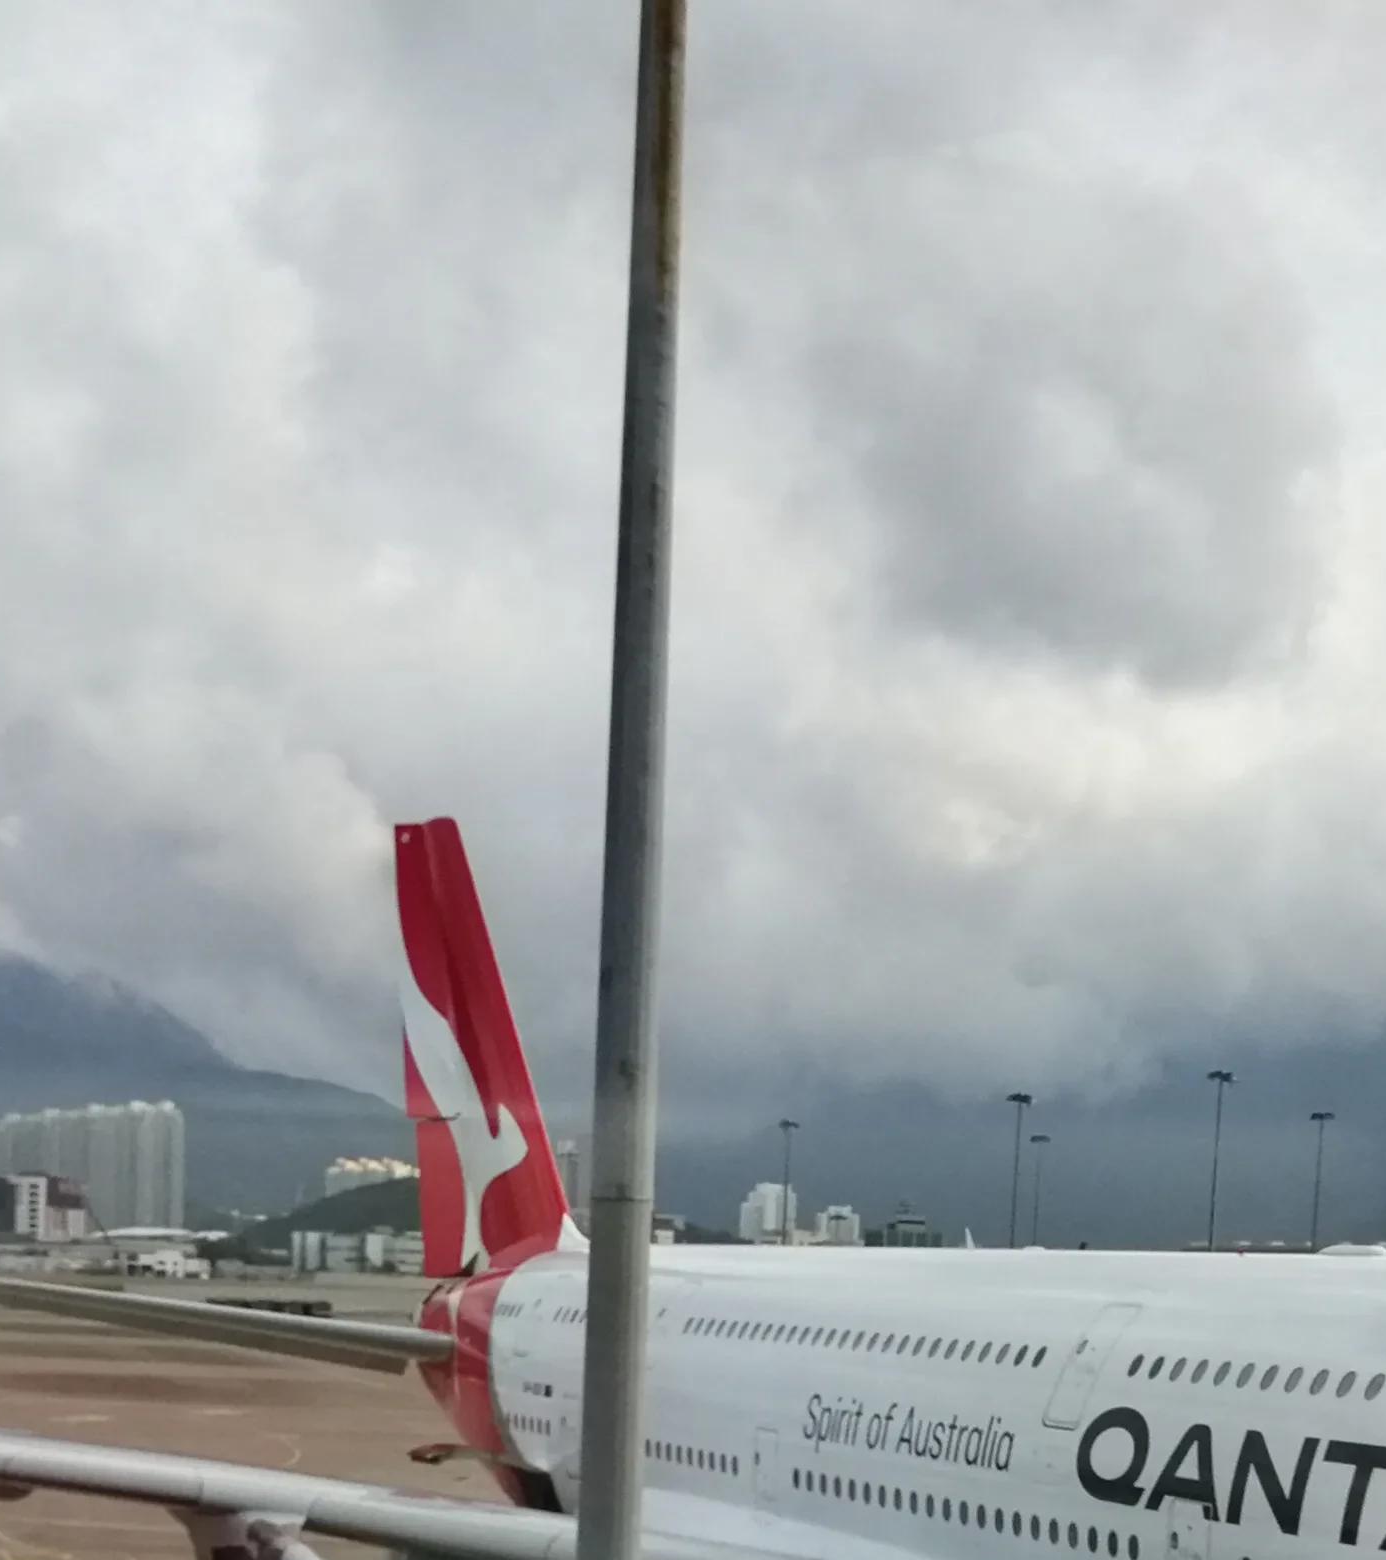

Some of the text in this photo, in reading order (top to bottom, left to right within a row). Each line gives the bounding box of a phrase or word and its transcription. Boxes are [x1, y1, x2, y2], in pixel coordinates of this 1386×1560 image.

[803, 1393, 1015, 1472] Spirit of Australia
